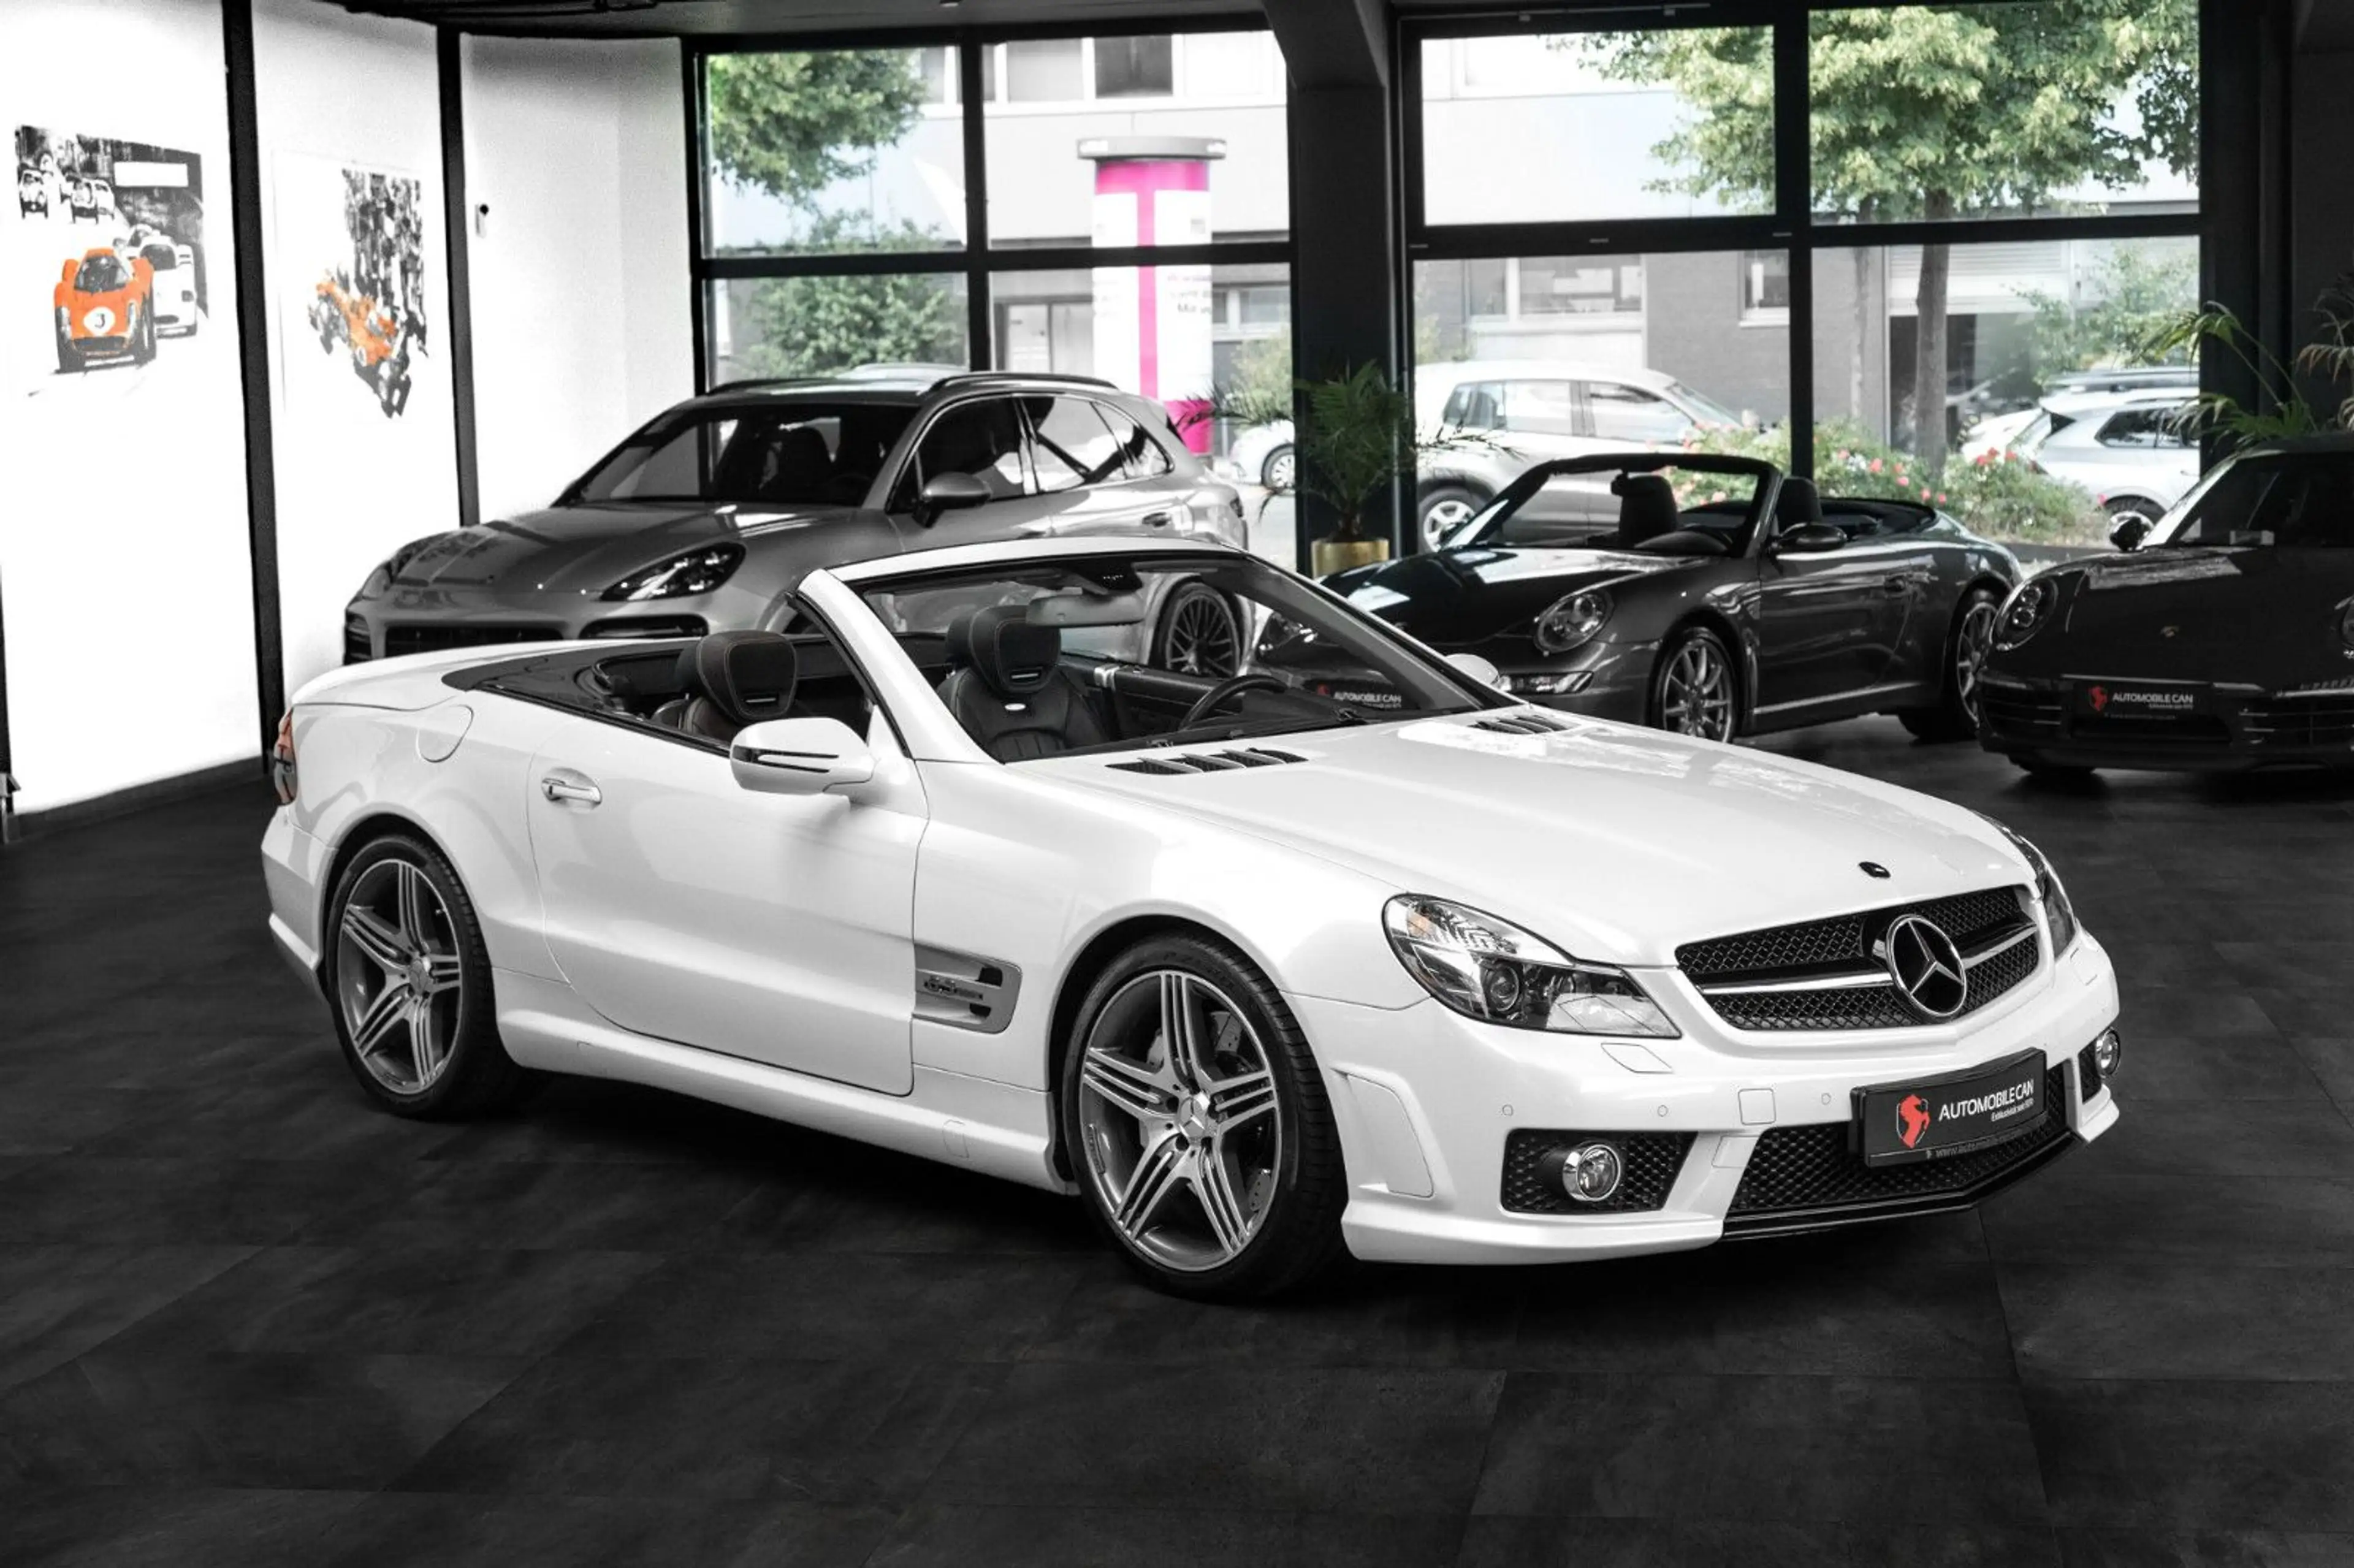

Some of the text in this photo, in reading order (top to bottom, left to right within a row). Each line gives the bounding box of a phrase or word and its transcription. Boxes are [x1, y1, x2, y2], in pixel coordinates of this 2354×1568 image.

[2112, 693, 2193, 703] AUTOMOBILE CAN
[1938, 1087, 2015, 1122] AUTOMOBILE
[2016, 1079, 2034, 1100] CAN
